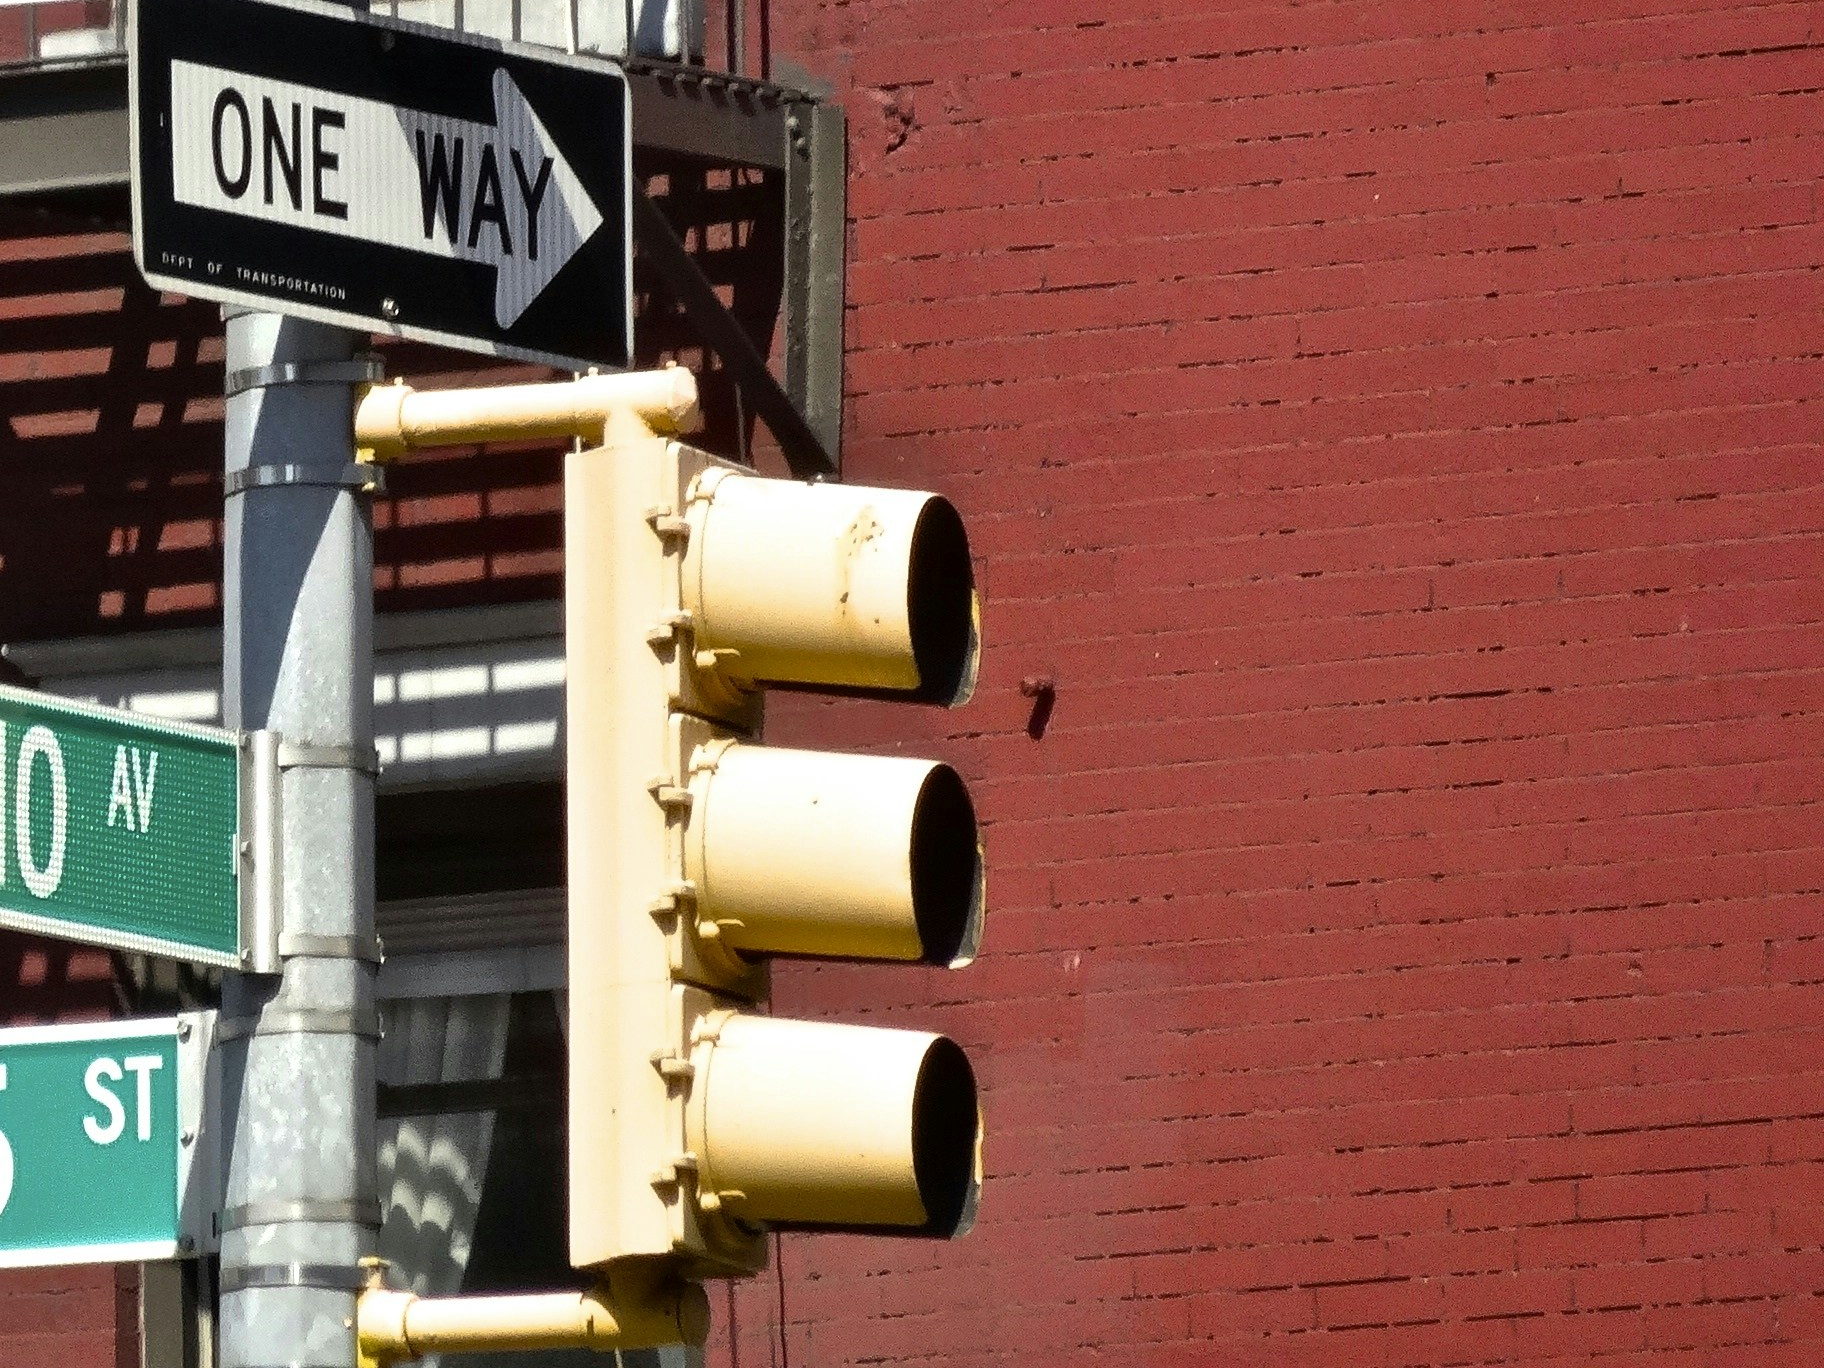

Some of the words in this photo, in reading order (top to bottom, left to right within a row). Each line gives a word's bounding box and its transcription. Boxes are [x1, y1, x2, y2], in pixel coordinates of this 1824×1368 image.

[211, 87, 348, 221] ONE
[415, 129, 553, 261] WAY
[162, 251, 193, 269] DEPT
[208, 262, 223, 274] OF
[237, 266, 346, 300] TRANSPORTATION
[108, 744, 158, 834] AV
[83, 1056, 163, 1144] ST
